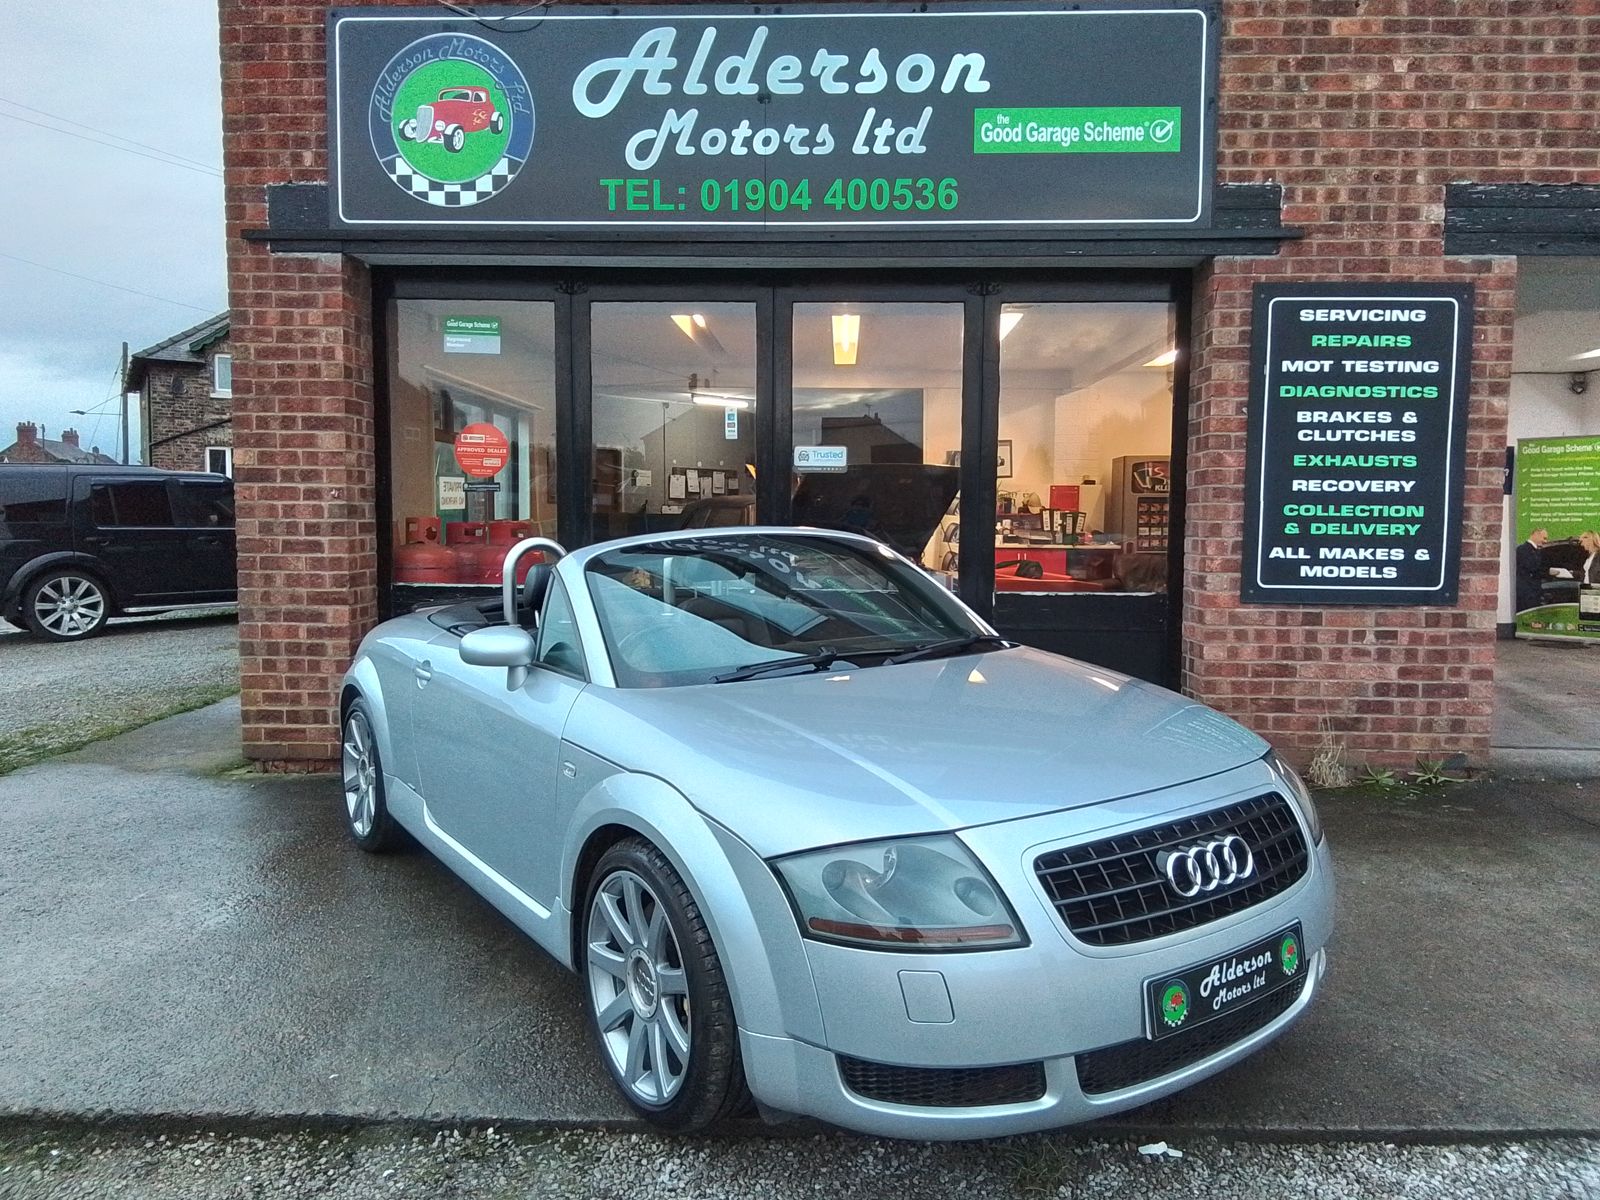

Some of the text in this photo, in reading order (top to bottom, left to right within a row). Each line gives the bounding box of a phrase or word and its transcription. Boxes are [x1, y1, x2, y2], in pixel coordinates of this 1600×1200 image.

[572, 25, 990, 119] Alderson
[375, 48, 434, 124] Alderson
[438, 38, 506, 75] Motors
[997, 114, 1009, 125] the
[625, 106, 933, 171] Motors ltd
[980, 122, 1145, 147] Good Garage Scheme
[600, 177, 959, 212] TEL: 01904 400536
[1300, 309, 1427, 322] SERVICING
[1311, 335, 1412, 347] REPAIRS
[1281, 360, 1440, 373] MOT TESTING
[1279, 385, 1439, 398] DIAGNOSTICS
[1296, 411, 1418, 423] BRAKES &
[1297, 430, 1416, 442] CLUTCHES
[812, 450, 843, 459] Trusted
[1522, 446, 1540, 454] Good
[1541, 445, 1565, 455] Garage
[1293, 455, 1417, 468] EXHAUSTS
[1292, 479, 1416, 493] RECOVERY
[1283, 504, 1425, 518] COLLECTION
[1284, 523, 1421, 536] & DELIVERY
[1269, 547, 1430, 561] ALL MAKES &
[1300, 566, 1398, 579] MODELS
[1200, 951, 1272, 997] Alderson
[1213, 970, 1266, 1010] Motors ltd
